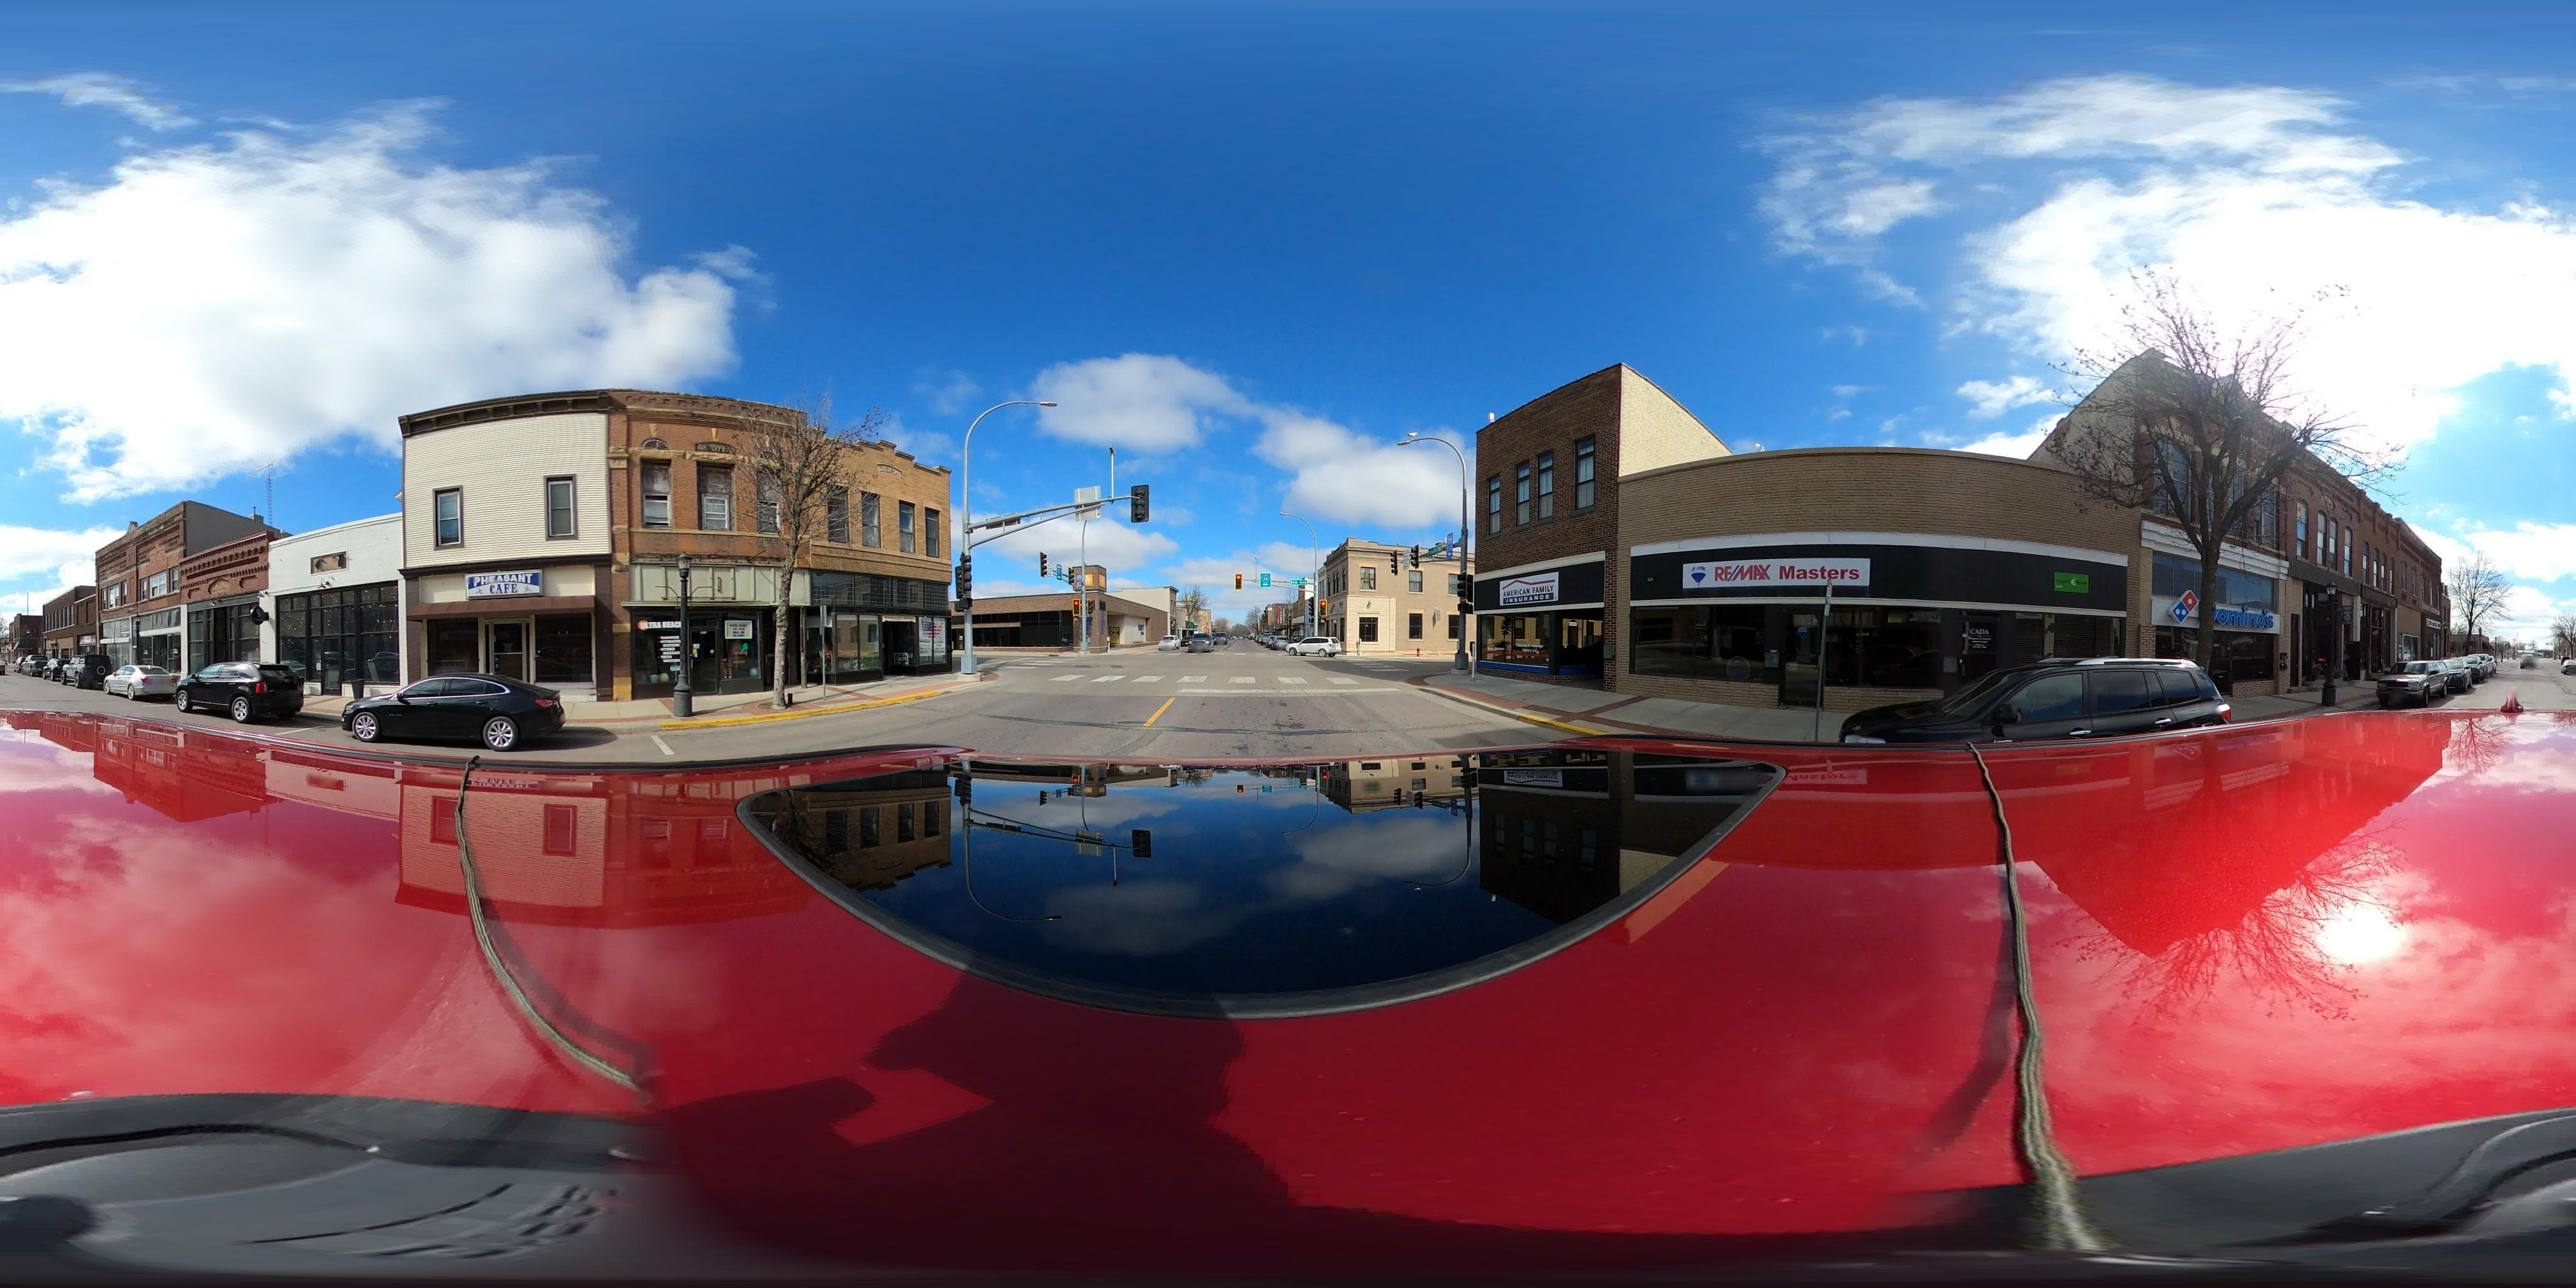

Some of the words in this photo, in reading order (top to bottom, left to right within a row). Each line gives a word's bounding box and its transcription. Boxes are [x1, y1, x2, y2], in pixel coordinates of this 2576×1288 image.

[1714, 564, 1772, 582] RE/MAX
[1779, 565, 1860, 580] Masters
[473, 573, 533, 587] PHEASANT
[489, 583, 518, 594] CAFE
[1503, 587, 1530, 597] AMERICAN
[1532, 584, 1554, 594] FAMILY
[1506, 594, 1550, 603] INSURANCE
[2212, 605, 2274, 629] omino's
